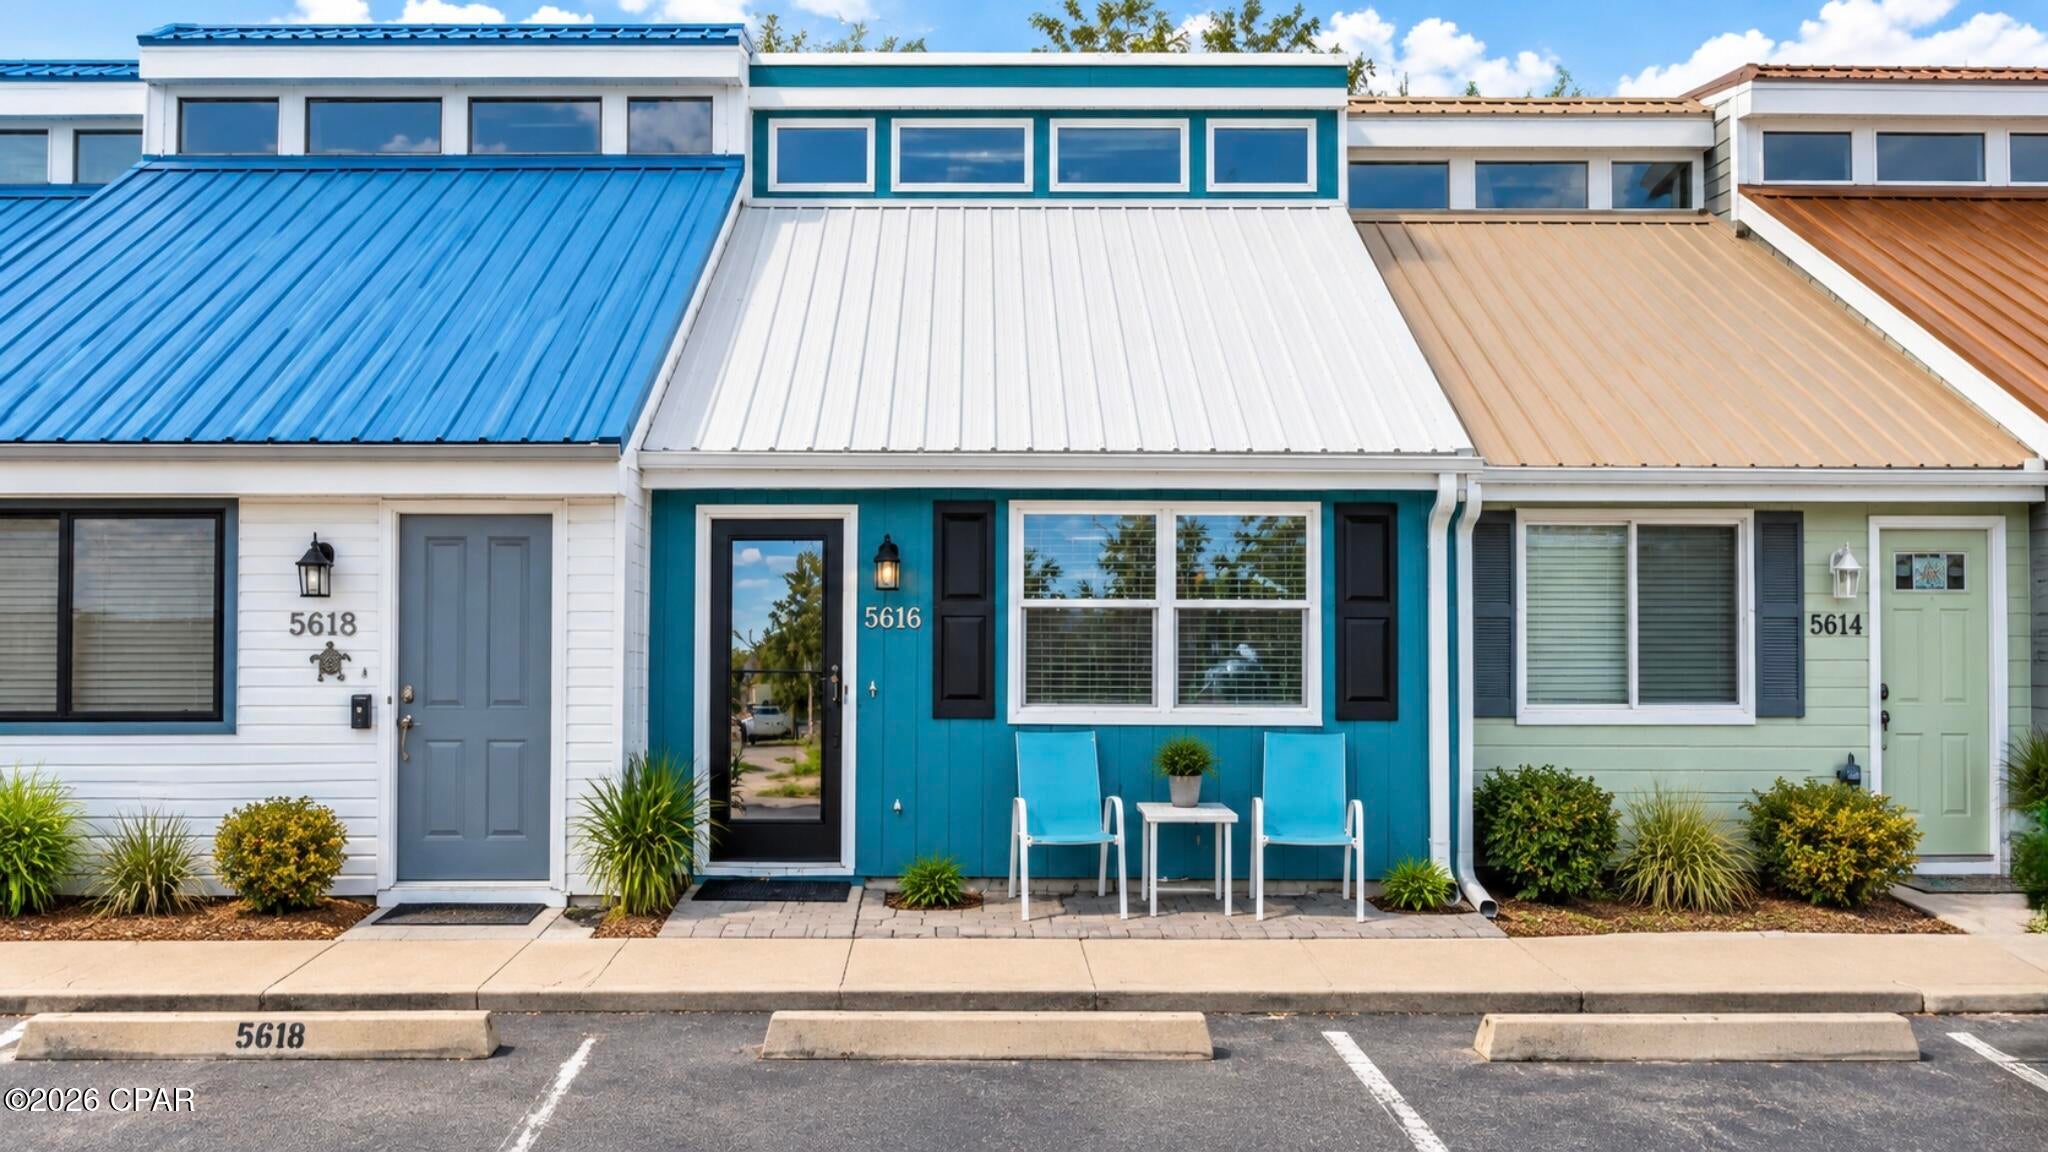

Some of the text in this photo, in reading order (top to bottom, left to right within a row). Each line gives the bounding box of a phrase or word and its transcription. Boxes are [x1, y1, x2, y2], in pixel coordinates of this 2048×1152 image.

[289, 611, 357, 636] 5618
[864, 606, 921, 629] 5616
[1810, 613, 1862, 636] 5614
[235, 1022, 305, 1049] 5618
